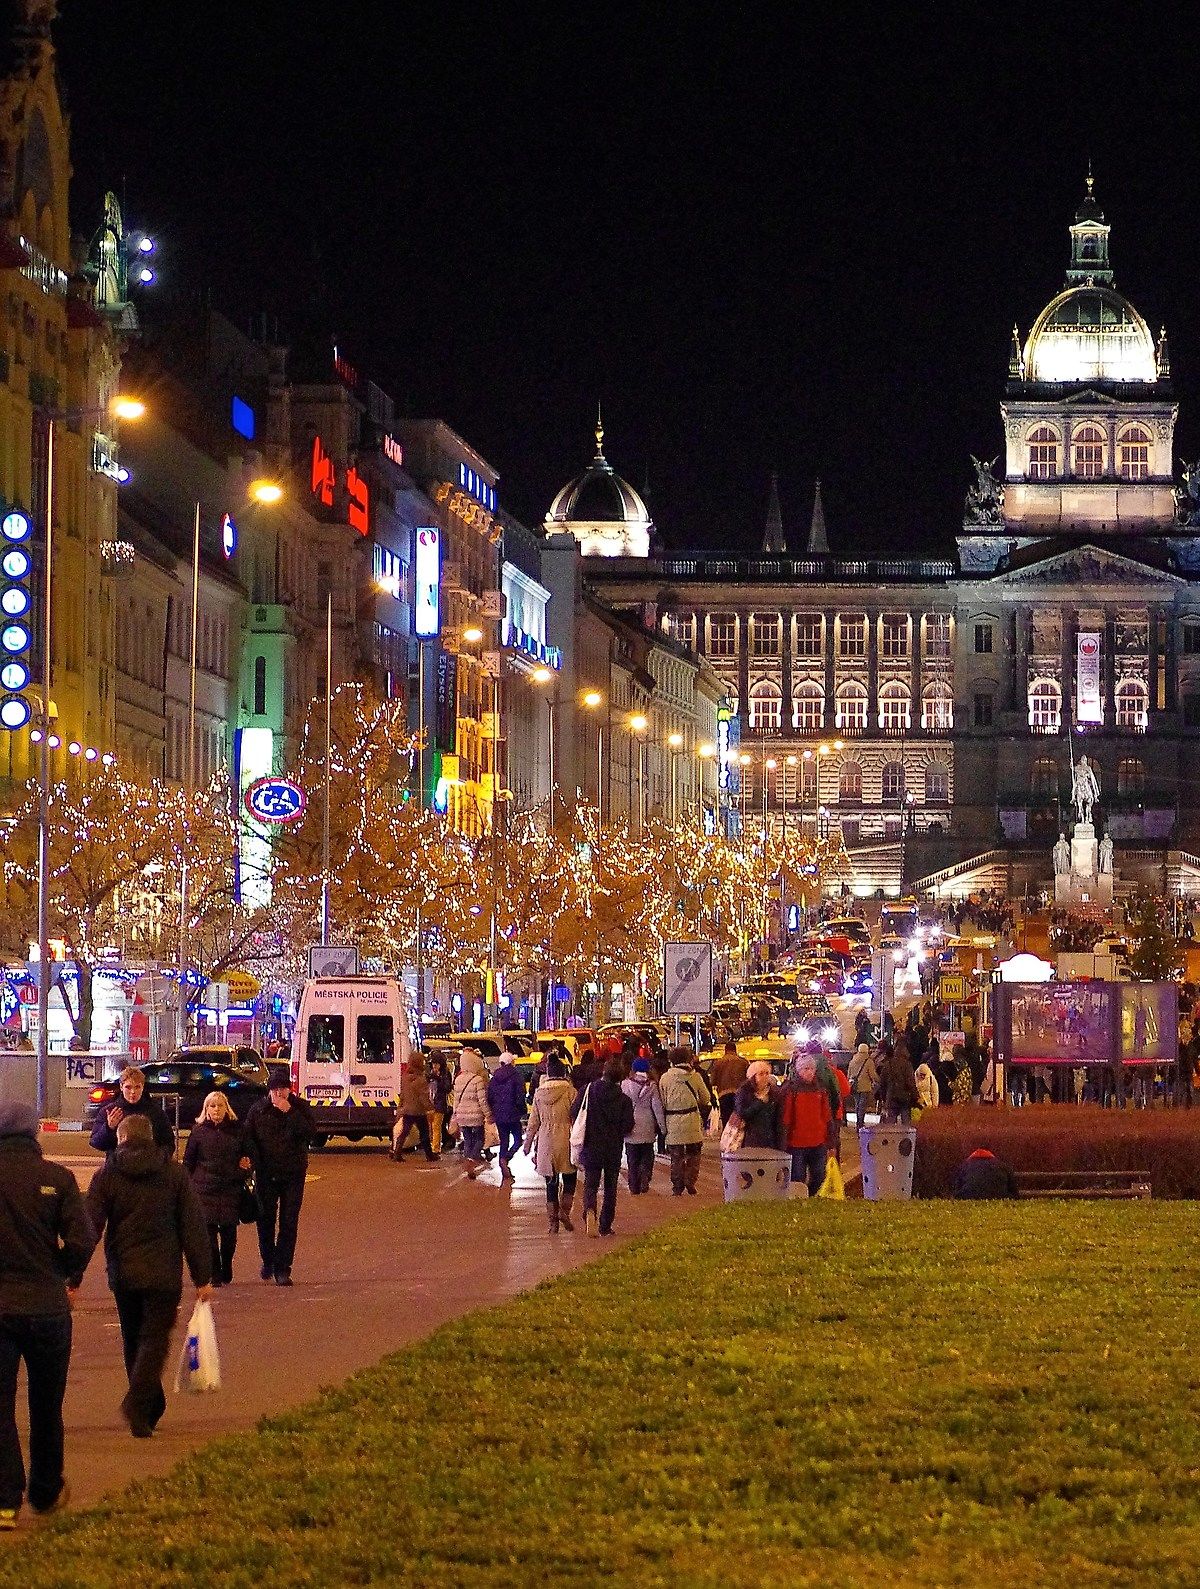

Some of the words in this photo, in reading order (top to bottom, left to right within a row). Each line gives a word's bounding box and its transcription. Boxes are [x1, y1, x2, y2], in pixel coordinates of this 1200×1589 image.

[256, 789, 295, 812] C&A
[944, 983, 959, 993] TAXI
[314, 989, 354, 999] MĚSTSKÁ
[356, 991, 388, 999] POLICIE
[373, 1090, 390, 1098] 156
